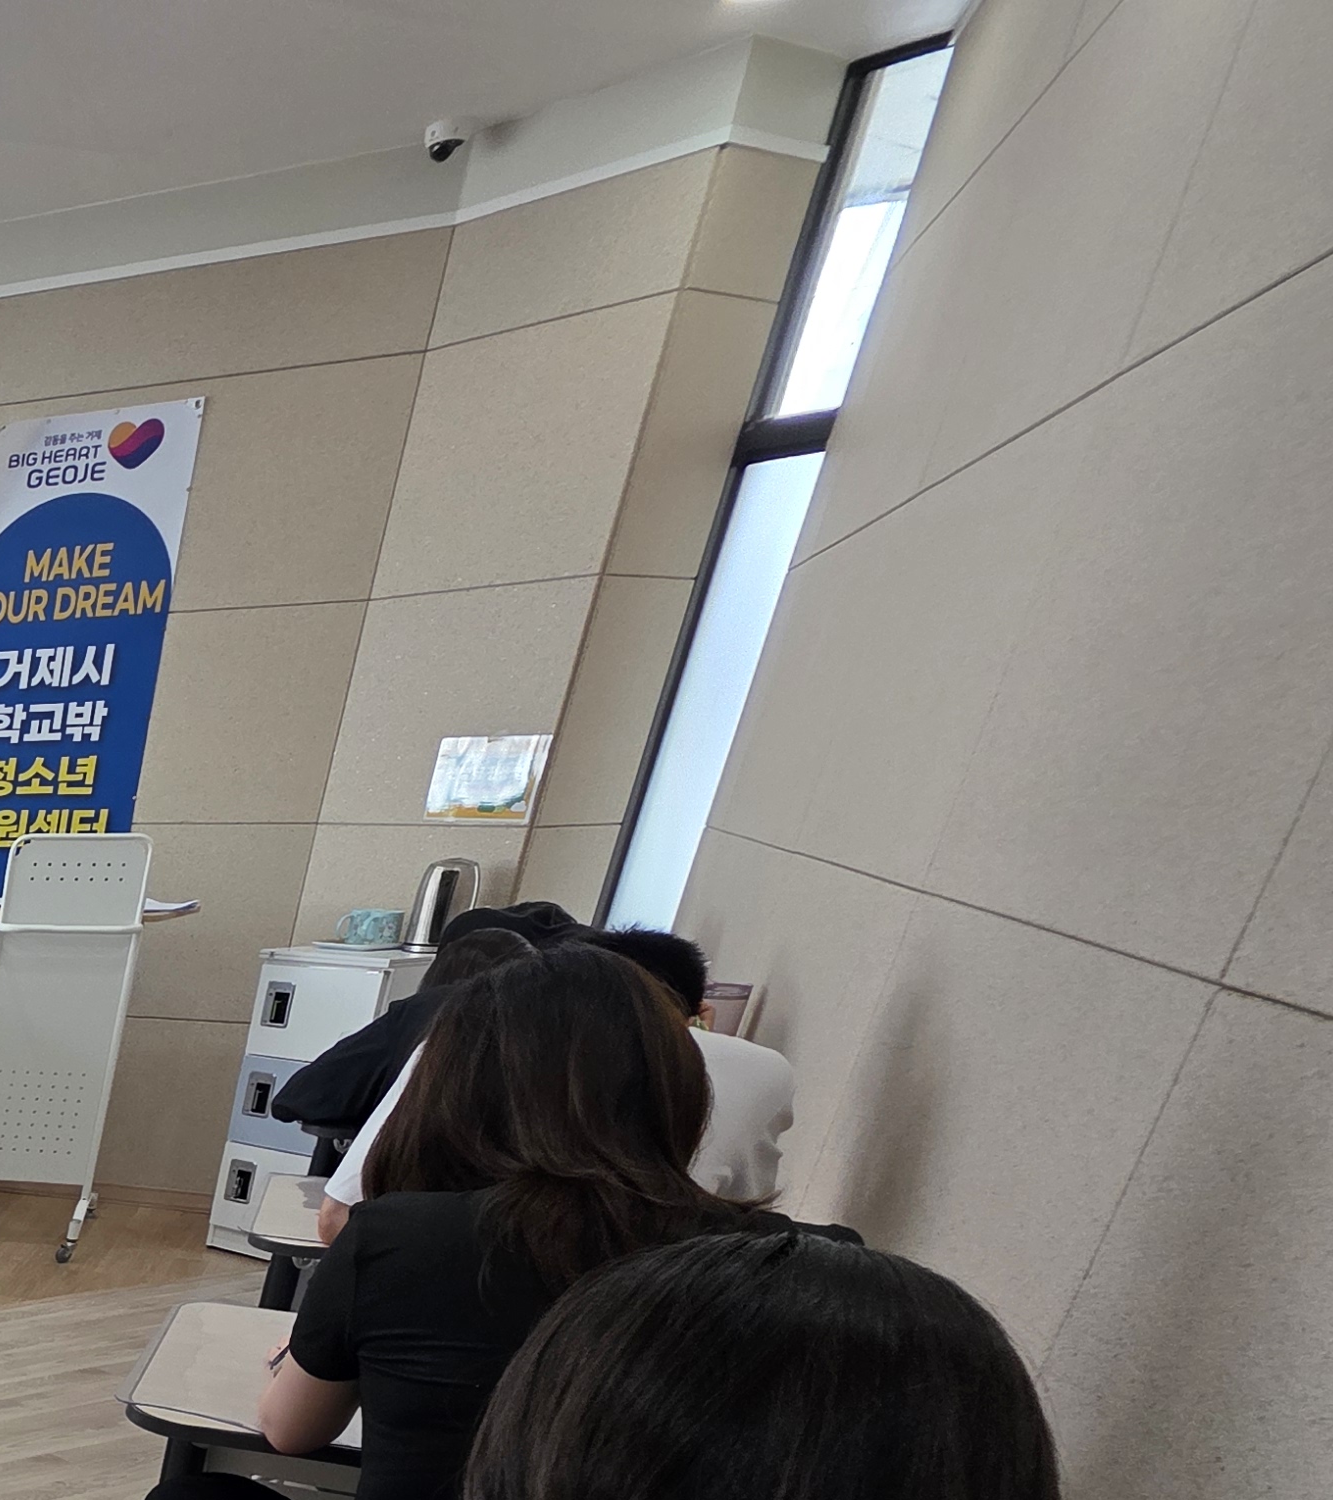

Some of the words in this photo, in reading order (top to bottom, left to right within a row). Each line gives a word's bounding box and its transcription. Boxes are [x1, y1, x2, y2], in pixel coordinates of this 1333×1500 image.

[8, 452, 38, 468] BIG
[41, 444, 102, 465] HEART
[27, 461, 107, 488] GEOJE
[23, 542, 115, 583] MAKE
[53, 579, 166, 621] DREAM
